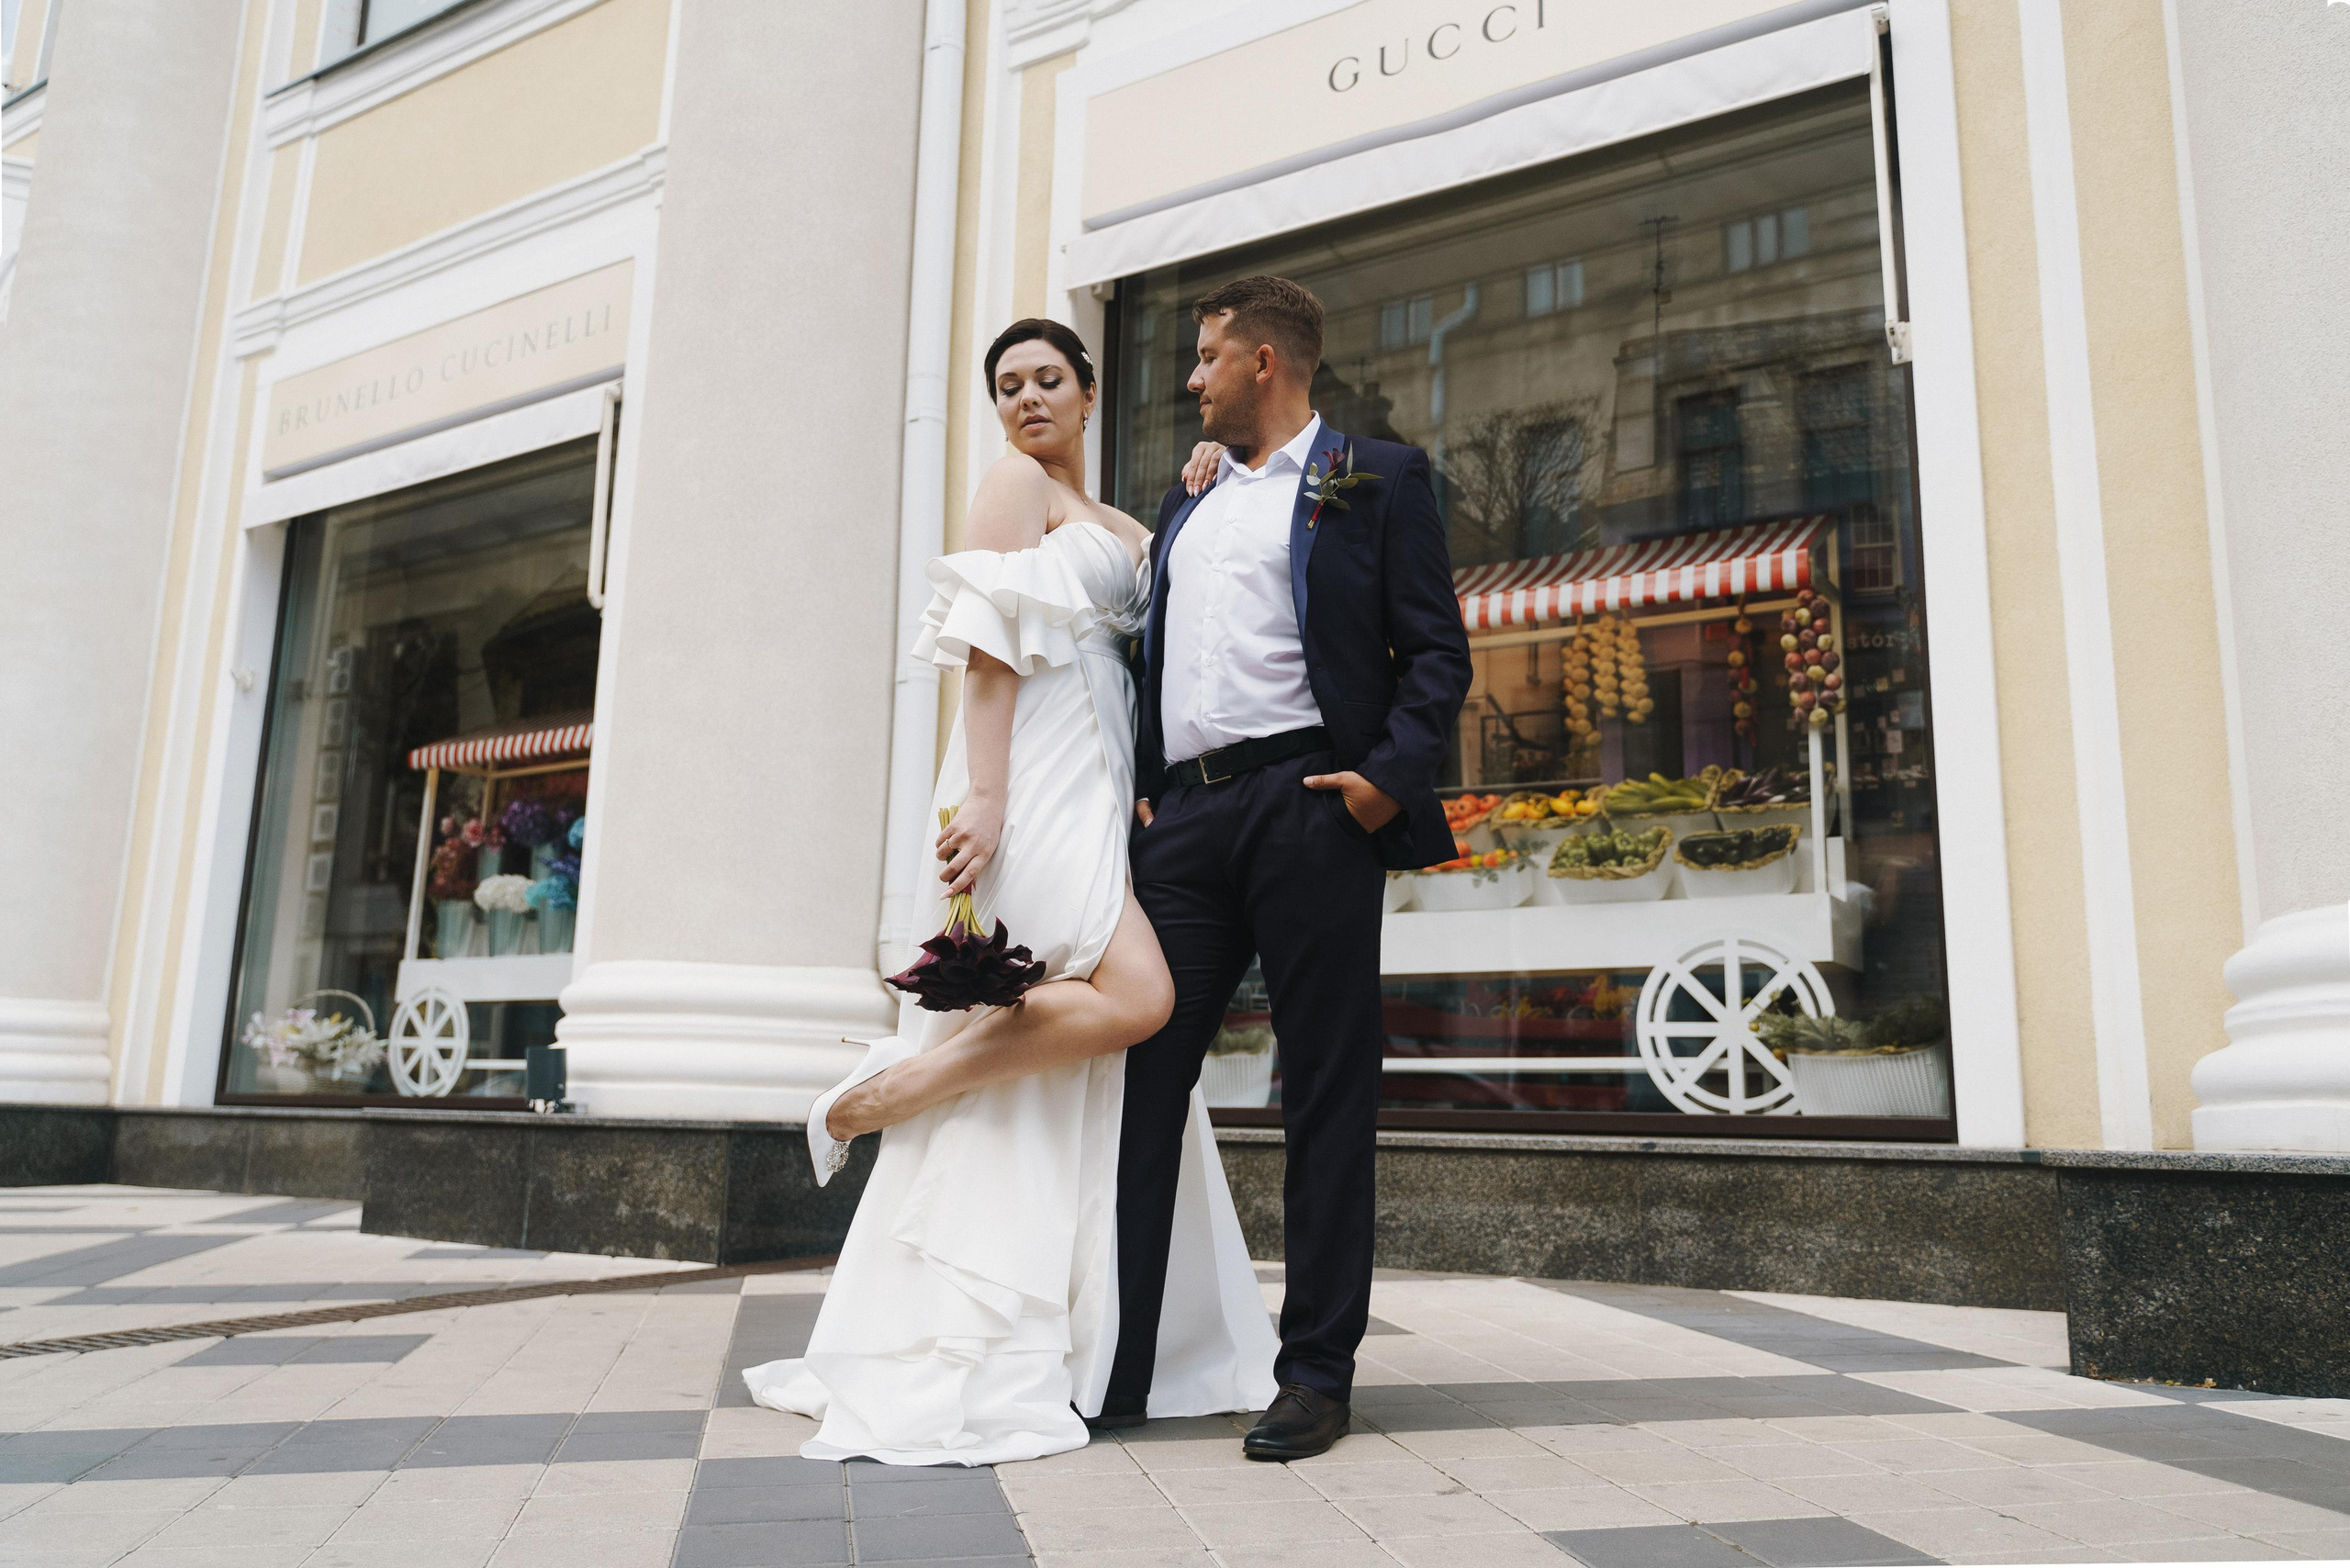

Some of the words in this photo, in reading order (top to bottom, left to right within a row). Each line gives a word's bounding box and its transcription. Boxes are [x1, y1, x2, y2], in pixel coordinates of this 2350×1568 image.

[1328, 0, 1544, 93] GUCCI
[278, 365, 425, 436] BRUNELLO
[440, 304, 610, 382] CUCINELLI
